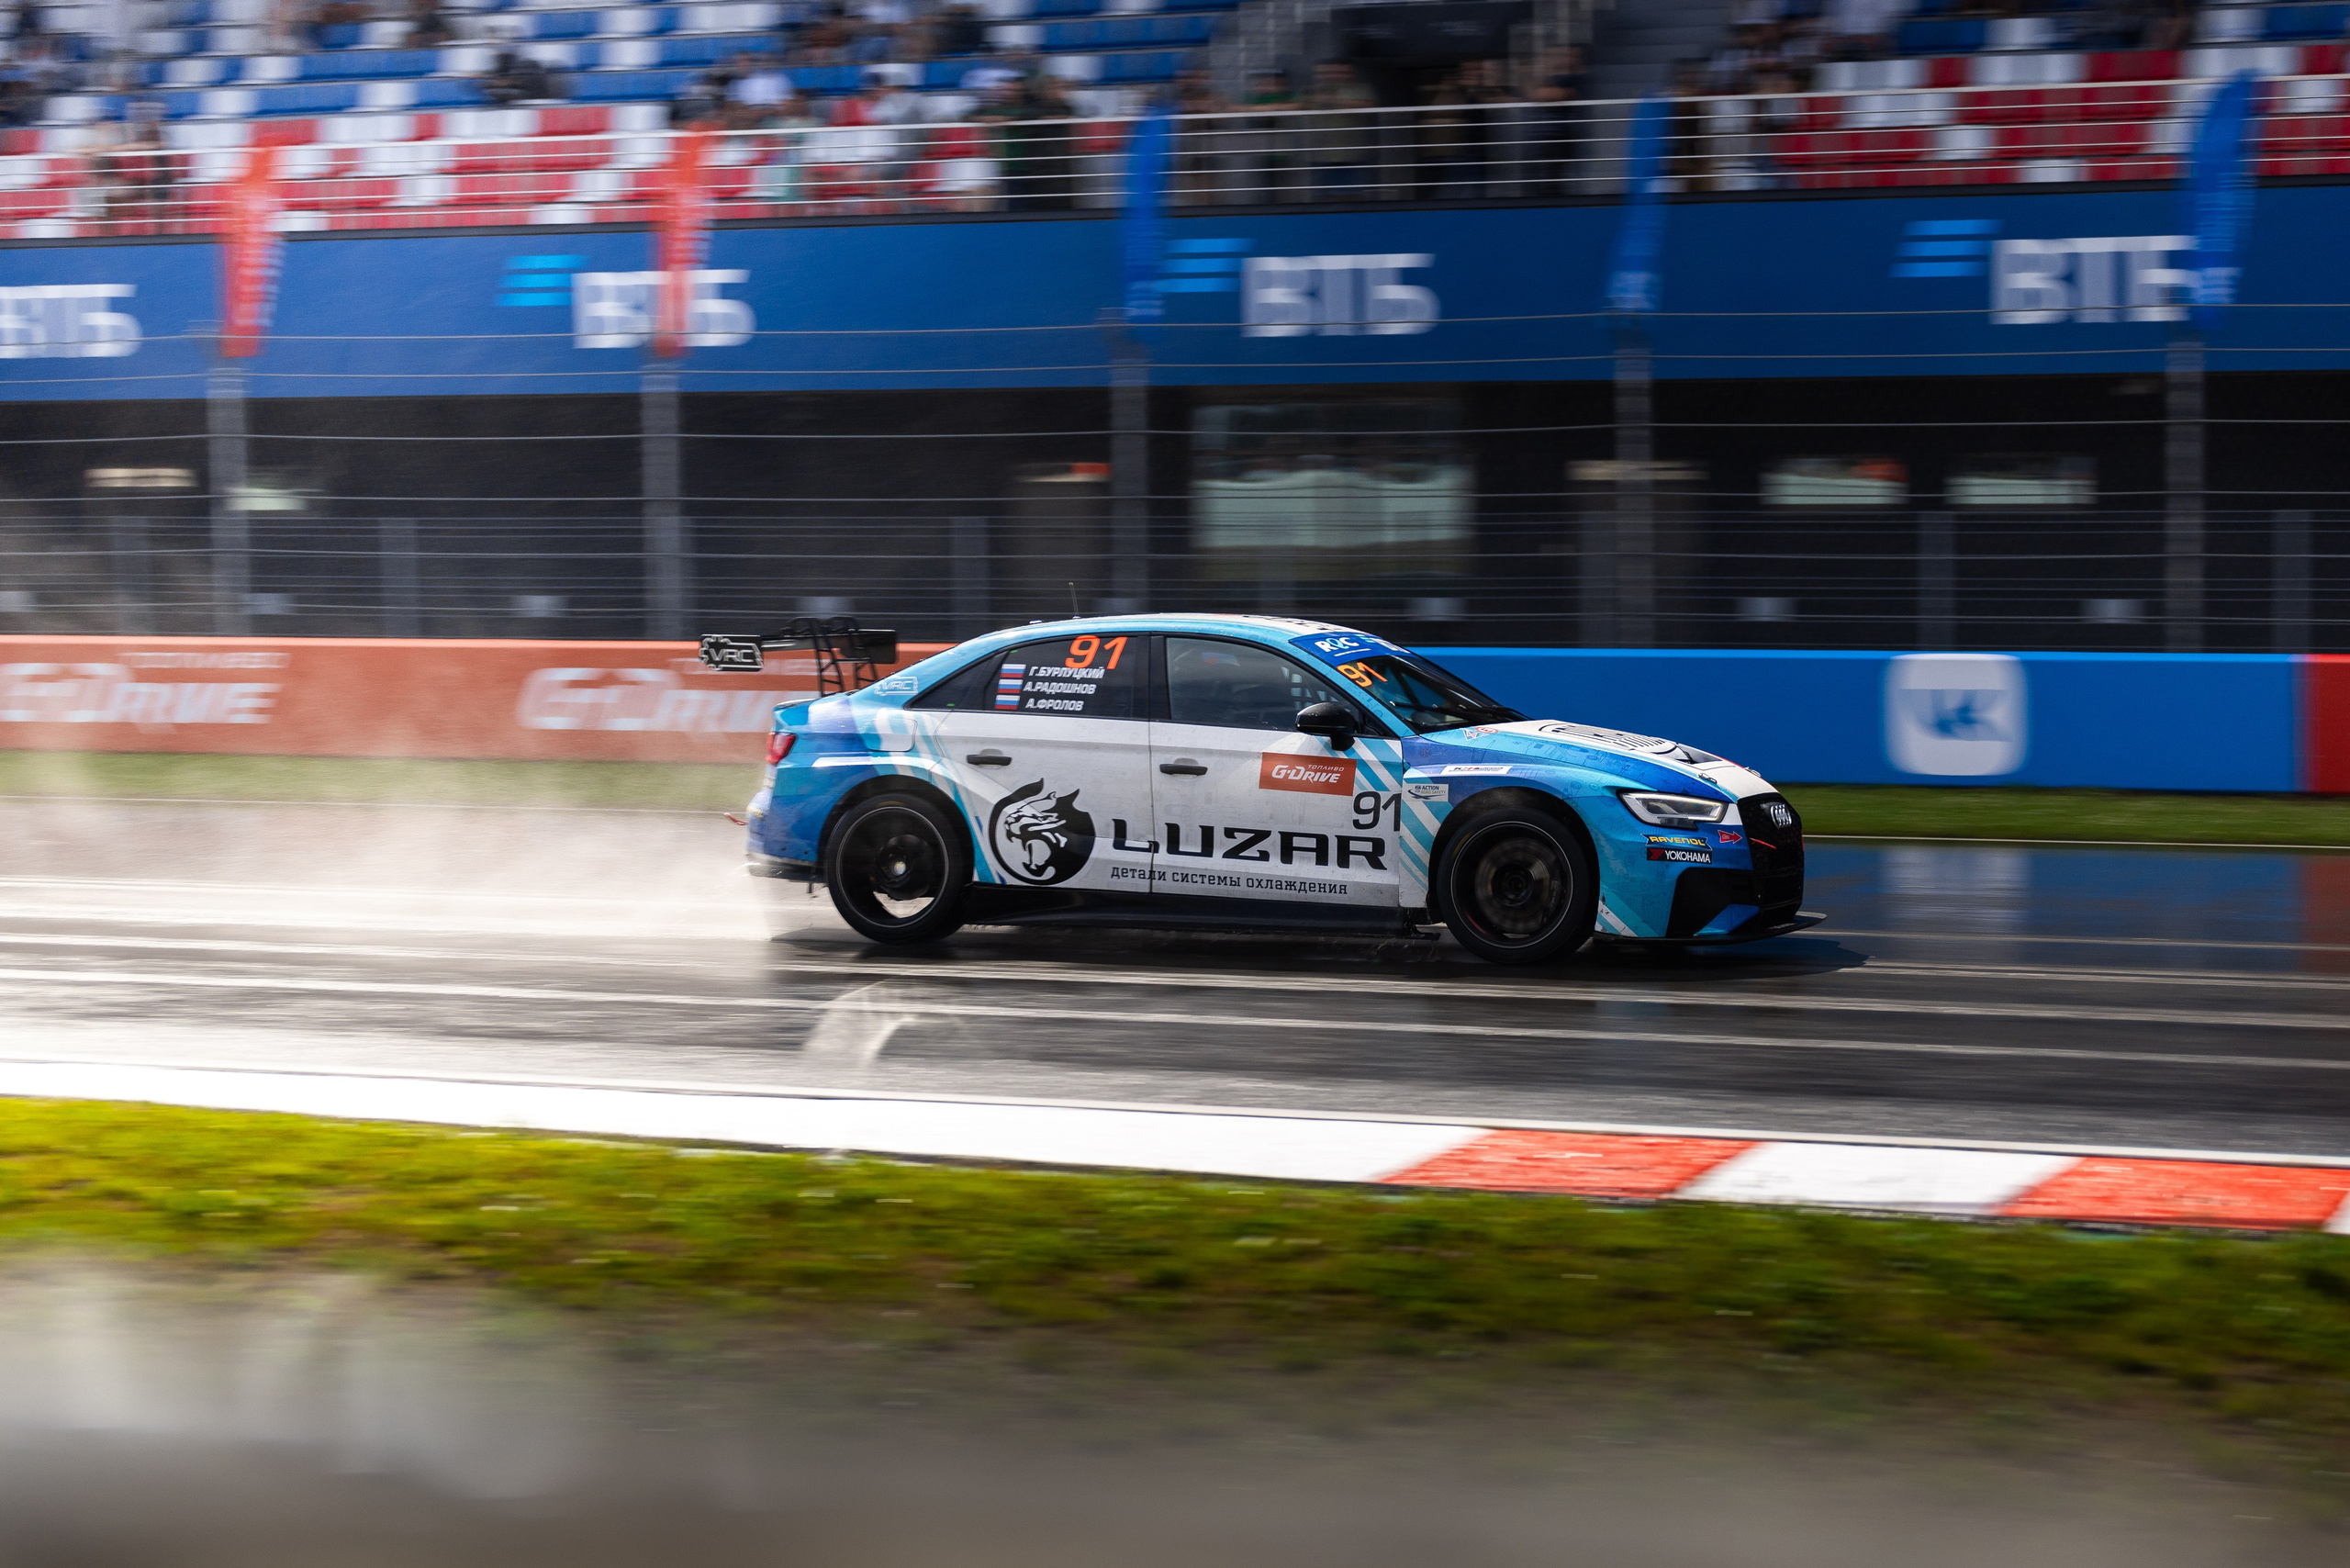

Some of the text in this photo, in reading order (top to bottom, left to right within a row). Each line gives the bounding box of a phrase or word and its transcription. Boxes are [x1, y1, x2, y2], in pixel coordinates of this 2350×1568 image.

[1240, 253, 1441, 337] ВТБ
[708, 648, 755, 663] VRC
[1065, 634, 1128, 670] 91
[880, 680, 913, 690] VRC
[1337, 662, 1388, 688] 91
[1025, 698, 1084, 711] А.ФРОЛОВ
[1307, 764, 1345, 772] ТОПЛИВО
[1352, 790, 1402, 832] 91
[1112, 818, 1388, 870] LUZAR
[1649, 835, 1706, 846] RAVENOL
[1664, 850, 1711, 864] YOKOHAMA
[1110, 866, 1348, 895] детали системы охлаждения
